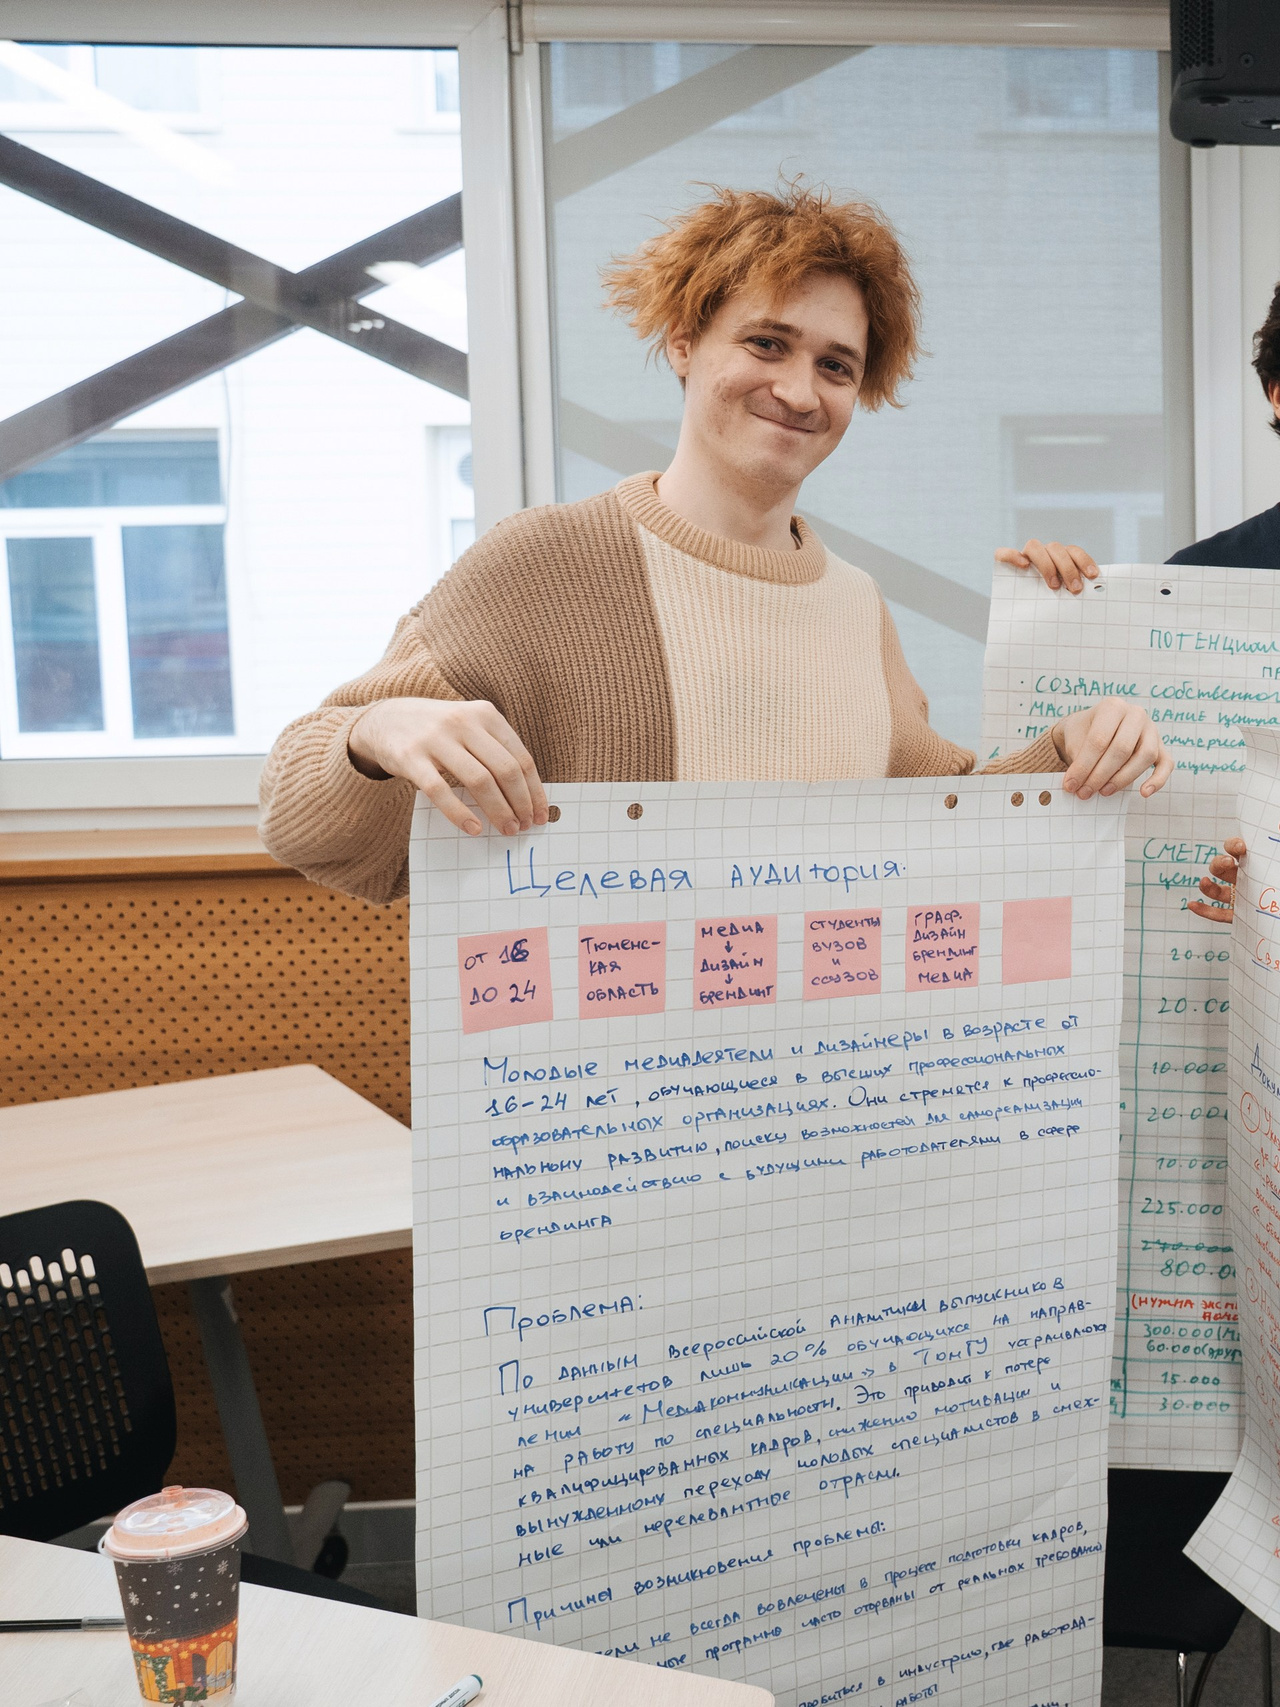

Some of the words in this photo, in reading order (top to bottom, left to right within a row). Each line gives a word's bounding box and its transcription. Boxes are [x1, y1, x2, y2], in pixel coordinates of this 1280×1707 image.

[509, 980, 536, 1003] 24
[485, 1092, 567, 1117] 16-24
[1141, 1198, 1221, 1214] 225.000
[1163, 1371, 1220, 1386] 15.000
[1161, 1397, 1229, 1413] 30.000
